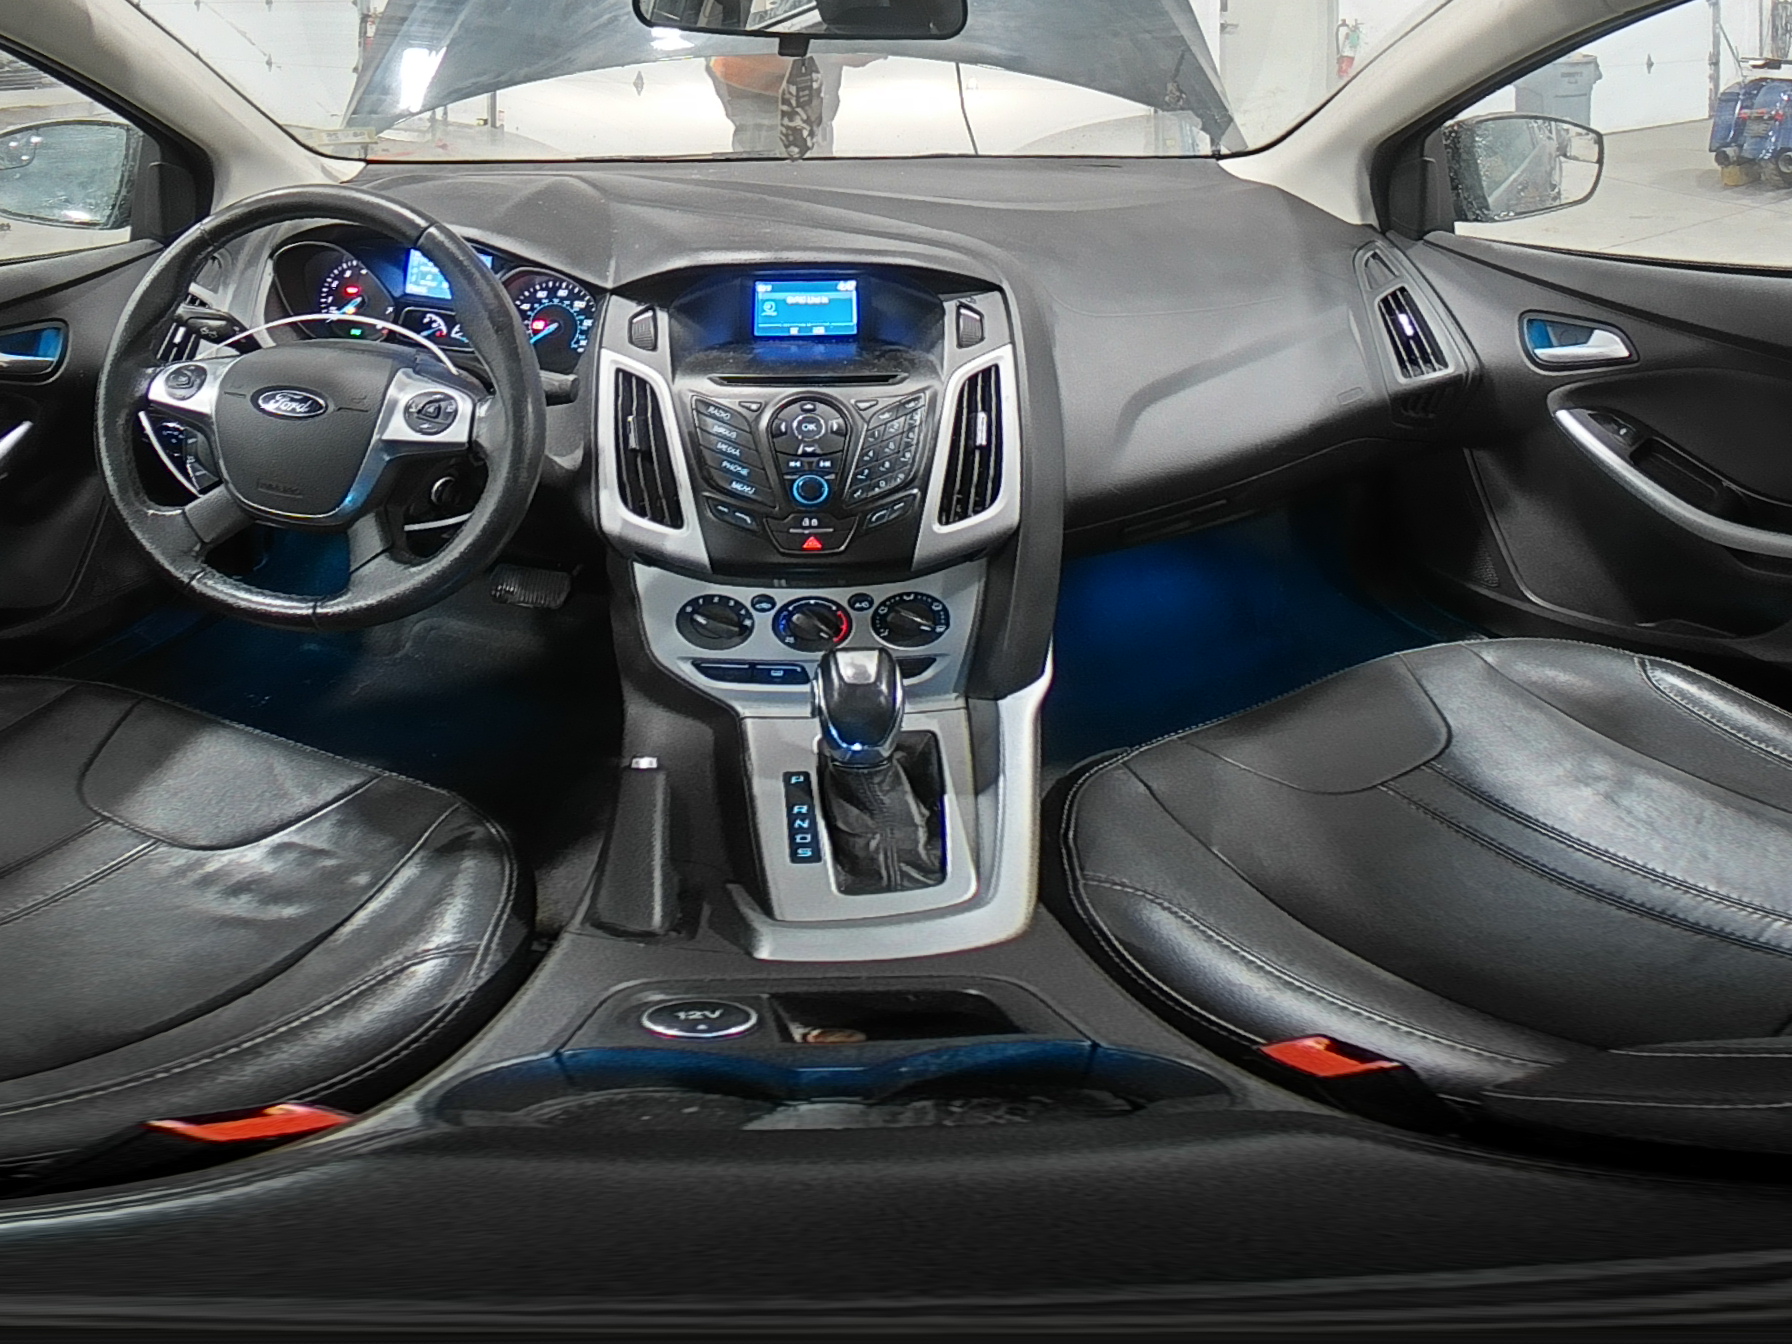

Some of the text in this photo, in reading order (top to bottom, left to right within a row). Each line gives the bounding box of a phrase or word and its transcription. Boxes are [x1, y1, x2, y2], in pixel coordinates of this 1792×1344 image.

[261, 392, 312, 413] Ford
[708, 405, 731, 420] RADIO
[802, 423, 817, 431] OK
[721, 460, 750, 477] PHONE
[790, 775, 804, 784] P
[792, 805, 809, 814] R
[794, 819, 810, 828] N
[795, 833, 811, 843] D
[797, 847, 813, 857] S
[674, 1009, 724, 1020] 12V
